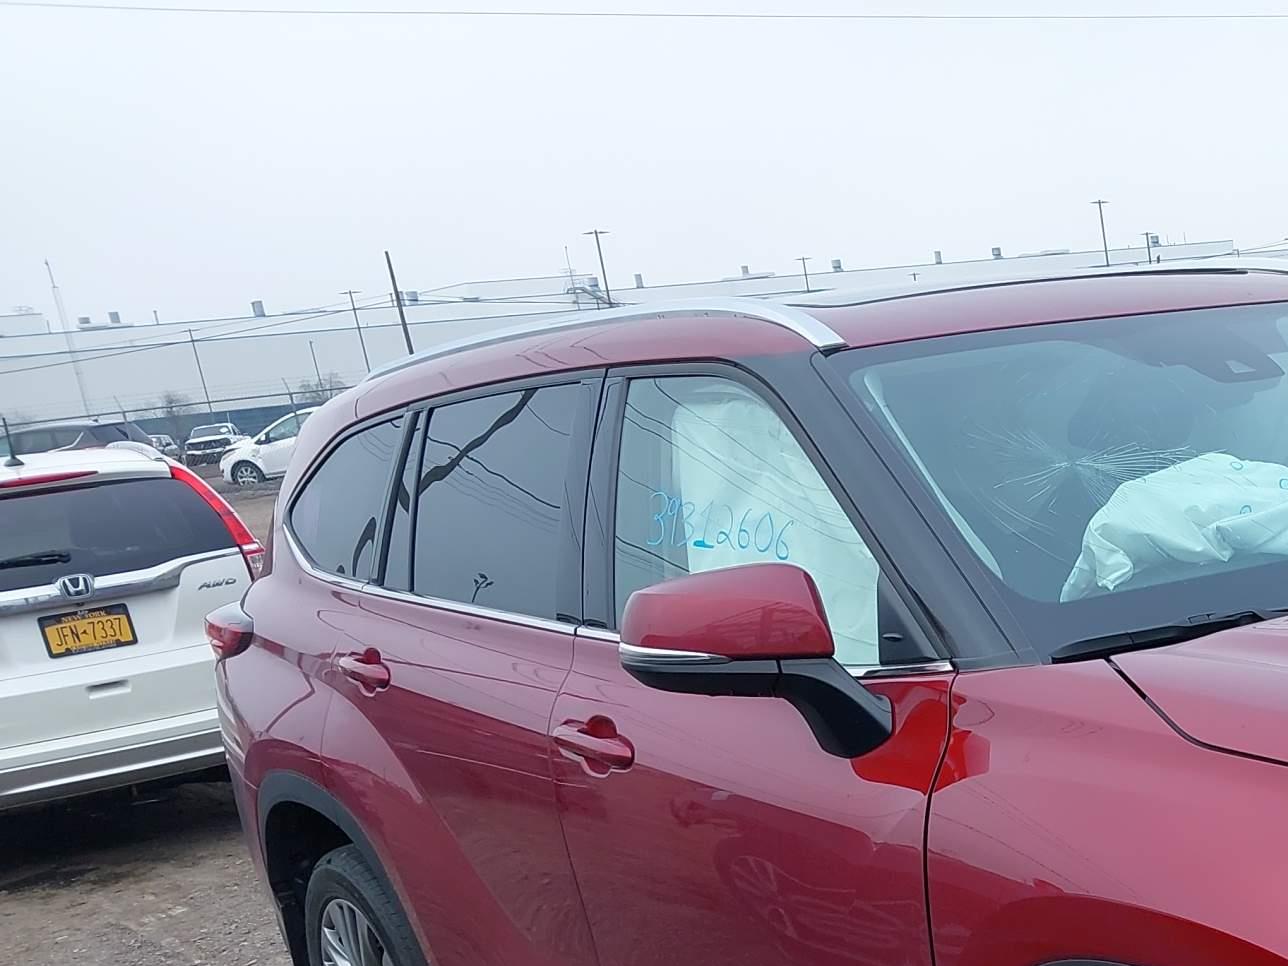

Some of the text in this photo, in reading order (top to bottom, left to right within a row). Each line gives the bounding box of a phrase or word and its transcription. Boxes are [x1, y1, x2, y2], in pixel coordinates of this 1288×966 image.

[647, 491, 794, 560] 39312606
[198, 578, 237, 590] AWD
[87, 617, 123, 641] 7337
